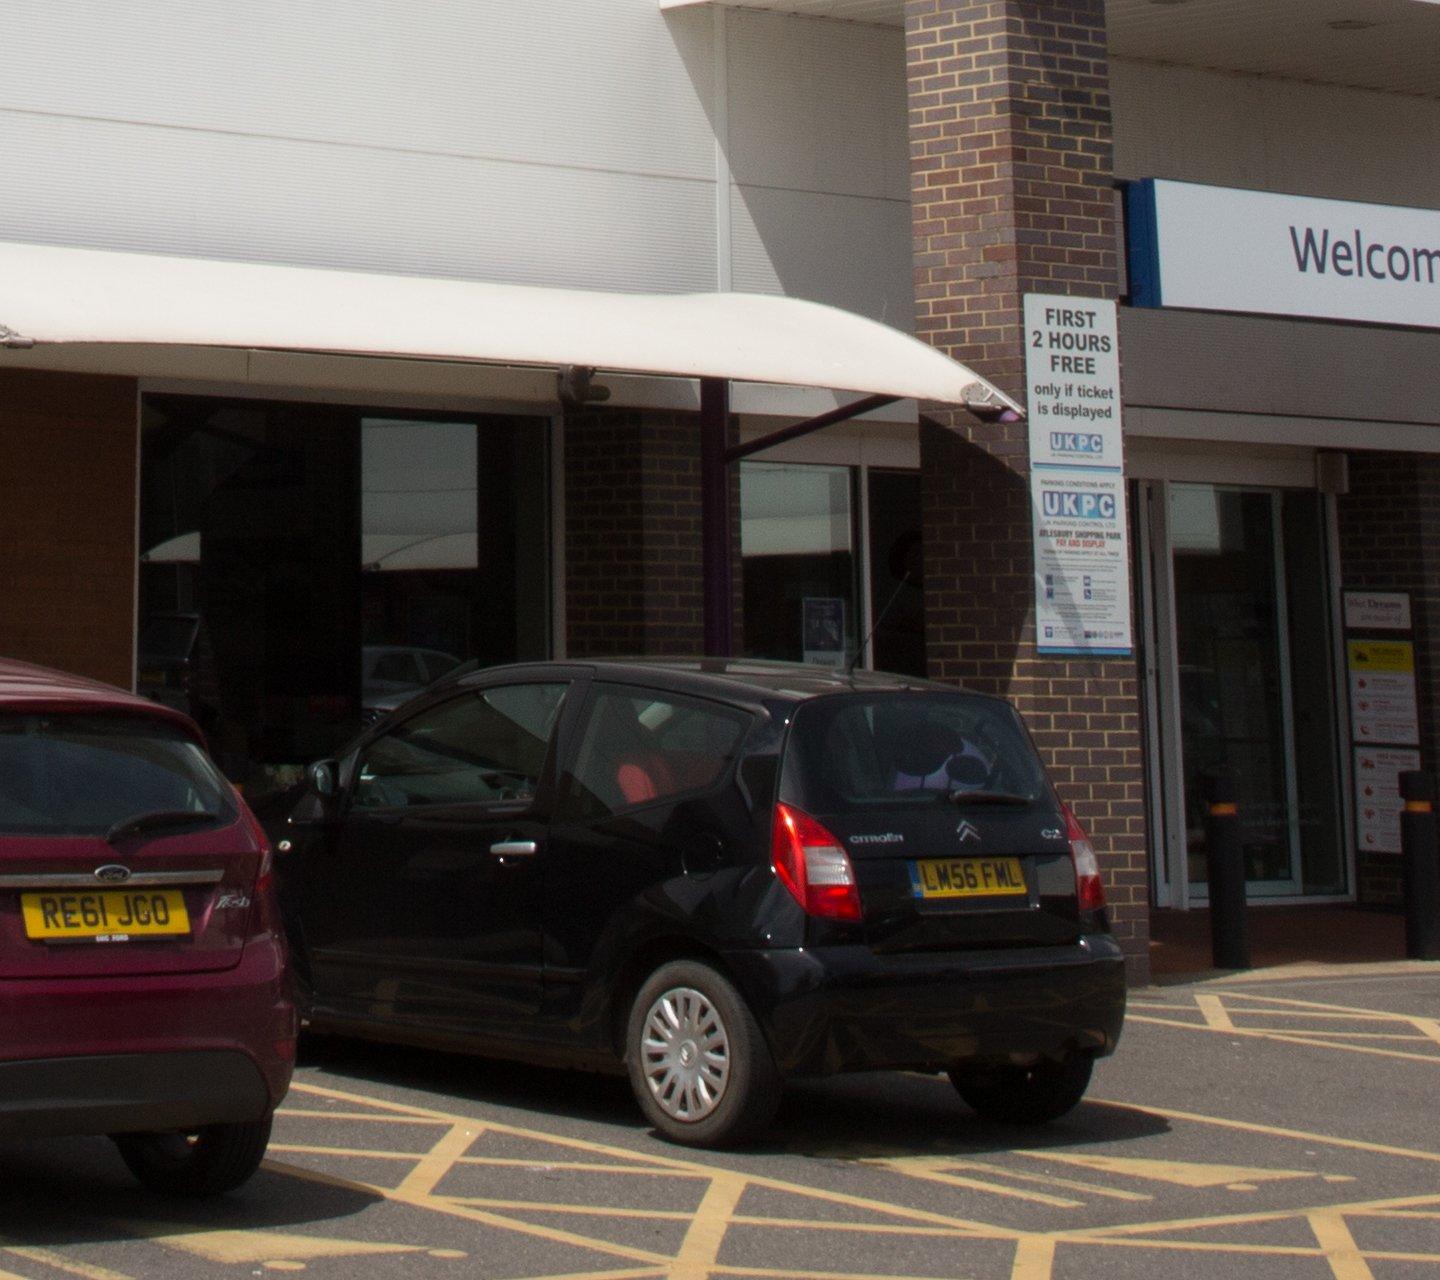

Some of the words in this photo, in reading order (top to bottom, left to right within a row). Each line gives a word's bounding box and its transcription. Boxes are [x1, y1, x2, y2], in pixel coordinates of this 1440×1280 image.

[1045, 308, 1096, 329] FIRST
[1032, 330, 1043, 348] 2
[1049, 331, 1112, 353] HOURS
[1051, 354, 1096, 375] FREE
[1034, 384, 1061, 400] only
[1064, 384, 1074, 398] if
[1077, 384, 1114, 400] ticket
[1037, 402, 1048, 416] is
[1051, 403, 1112, 421] displayed
[1050, 432, 1103, 453] UKPC
[1042, 491, 1116, 519] UKPC
[920, 868, 980, 891] LM56
[982, 867, 1024, 889] FML
[39, 895, 109, 929] RE61
[117, 894, 170, 927] JGO
